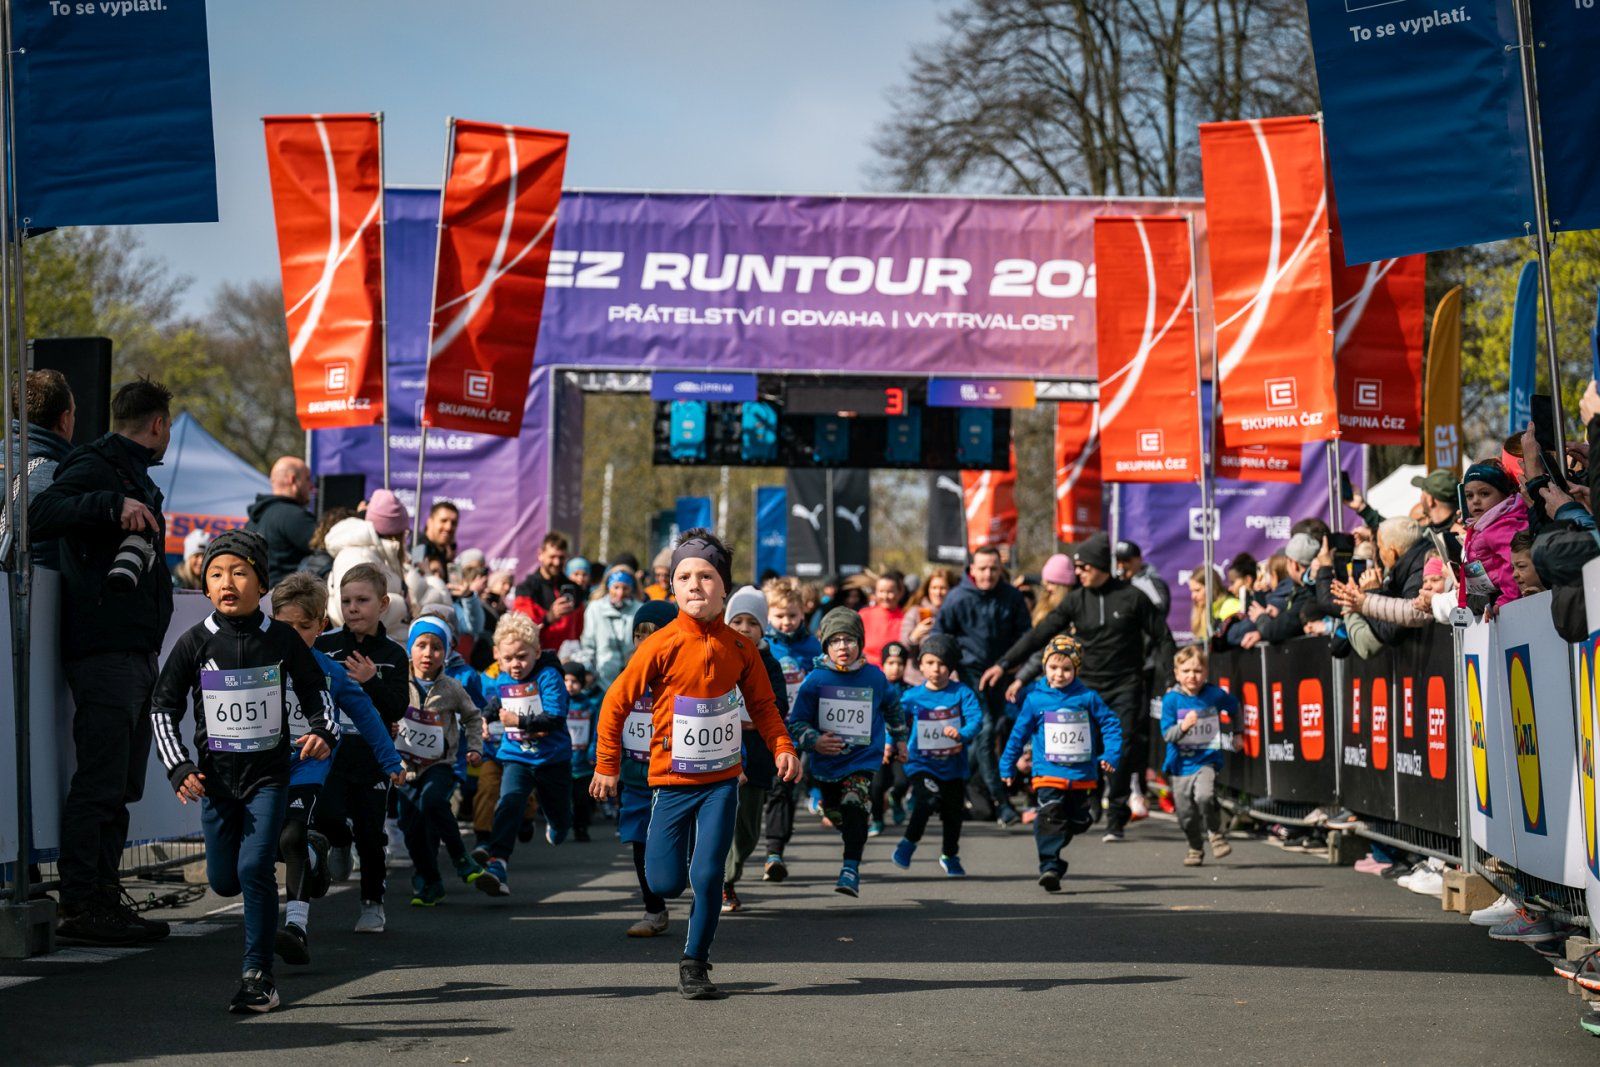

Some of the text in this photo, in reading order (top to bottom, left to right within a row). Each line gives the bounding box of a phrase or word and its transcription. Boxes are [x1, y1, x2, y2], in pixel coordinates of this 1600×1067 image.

[49, 1, 71, 16] To
[75, 2, 95, 15] se
[1350, 6, 1471, 42] To se vyplatí.
[640, 252, 973, 296] RUNTOUR
[608, 303, 764, 326] PŘÁTELSTVÍ
[781, 309, 886, 328] ODVAHA
[905, 311, 1075, 331] VYTRVALOST
[308, 396, 371, 414] SKUPINA ČEZ
[885, 387, 903, 415] 3
[438, 402, 512, 422] SKUPINA ČEZ
[1241, 411, 1324, 431] SKUPINA ČEZ
[1381, 415, 1405, 429] ČEZ
[389, 434, 473, 450] SKUPNA ČEZ
[1116, 457, 1187, 472] SKUPINA ČEZ
[1221, 455, 1289, 470] SKUPINA ČEZ
[216, 700, 267, 722] 6051
[826, 707, 865, 724] 6078
[1301, 703, 1321, 727] EPP
[1373, 706, 1387, 731] EPP
[628, 721, 654, 739] 451
[1429, 708, 1445, 736] EPP
[398, 727, 437, 749] 4722
[683, 723, 734, 746] 6008
[1052, 731, 1085, 745] 6024
